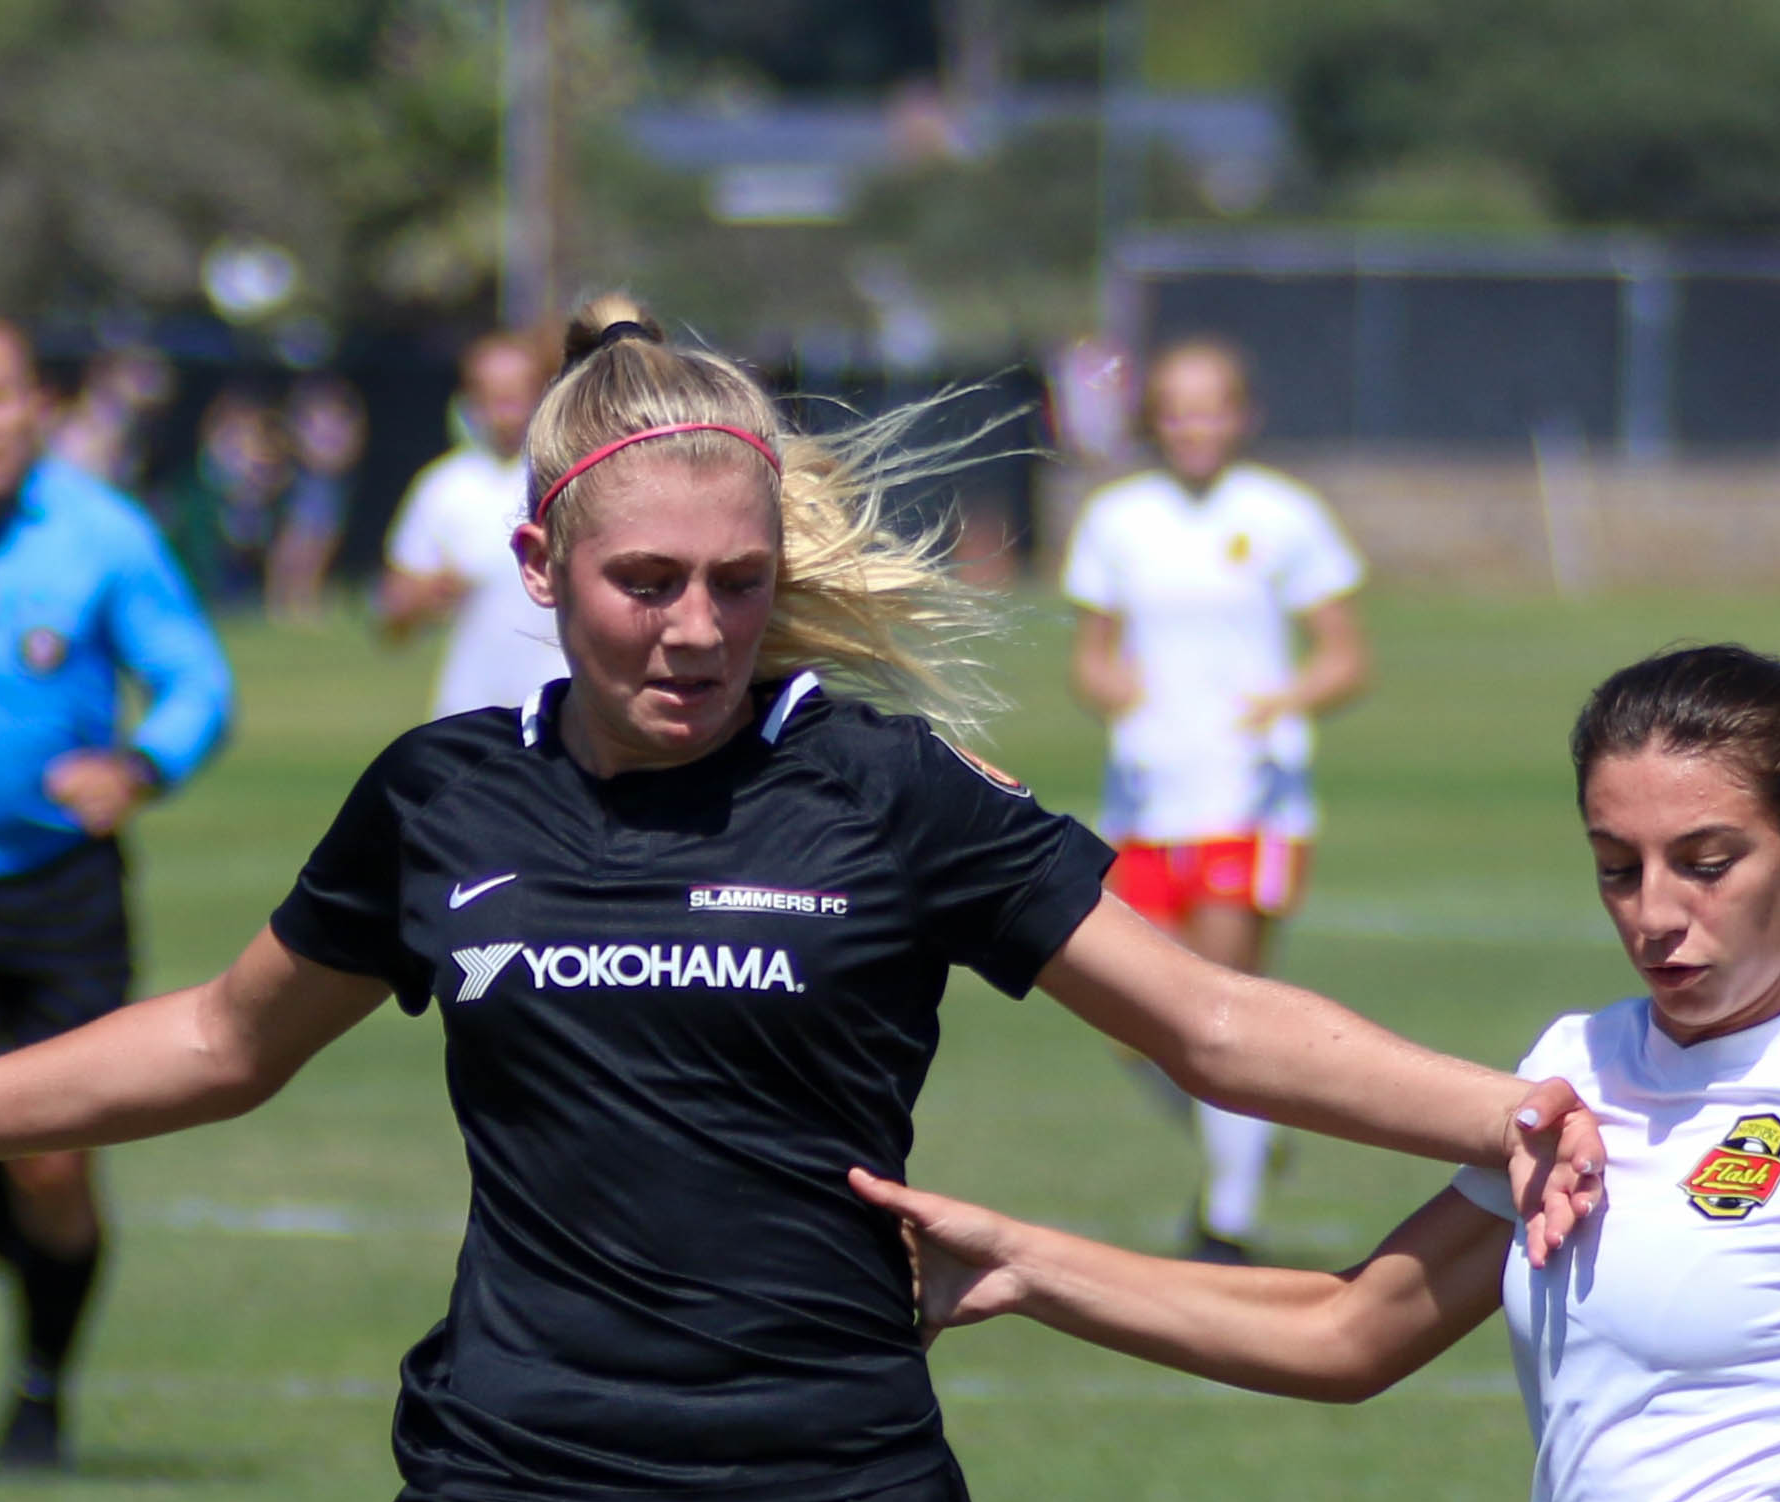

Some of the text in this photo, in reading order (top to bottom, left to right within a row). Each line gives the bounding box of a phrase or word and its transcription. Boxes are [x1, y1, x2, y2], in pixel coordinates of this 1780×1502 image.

[689, 889, 848, 916] SLAMMERS FC
[523, 944, 798, 992] YOKOHAMA
[1691, 1157, 1772, 1186] Flash
